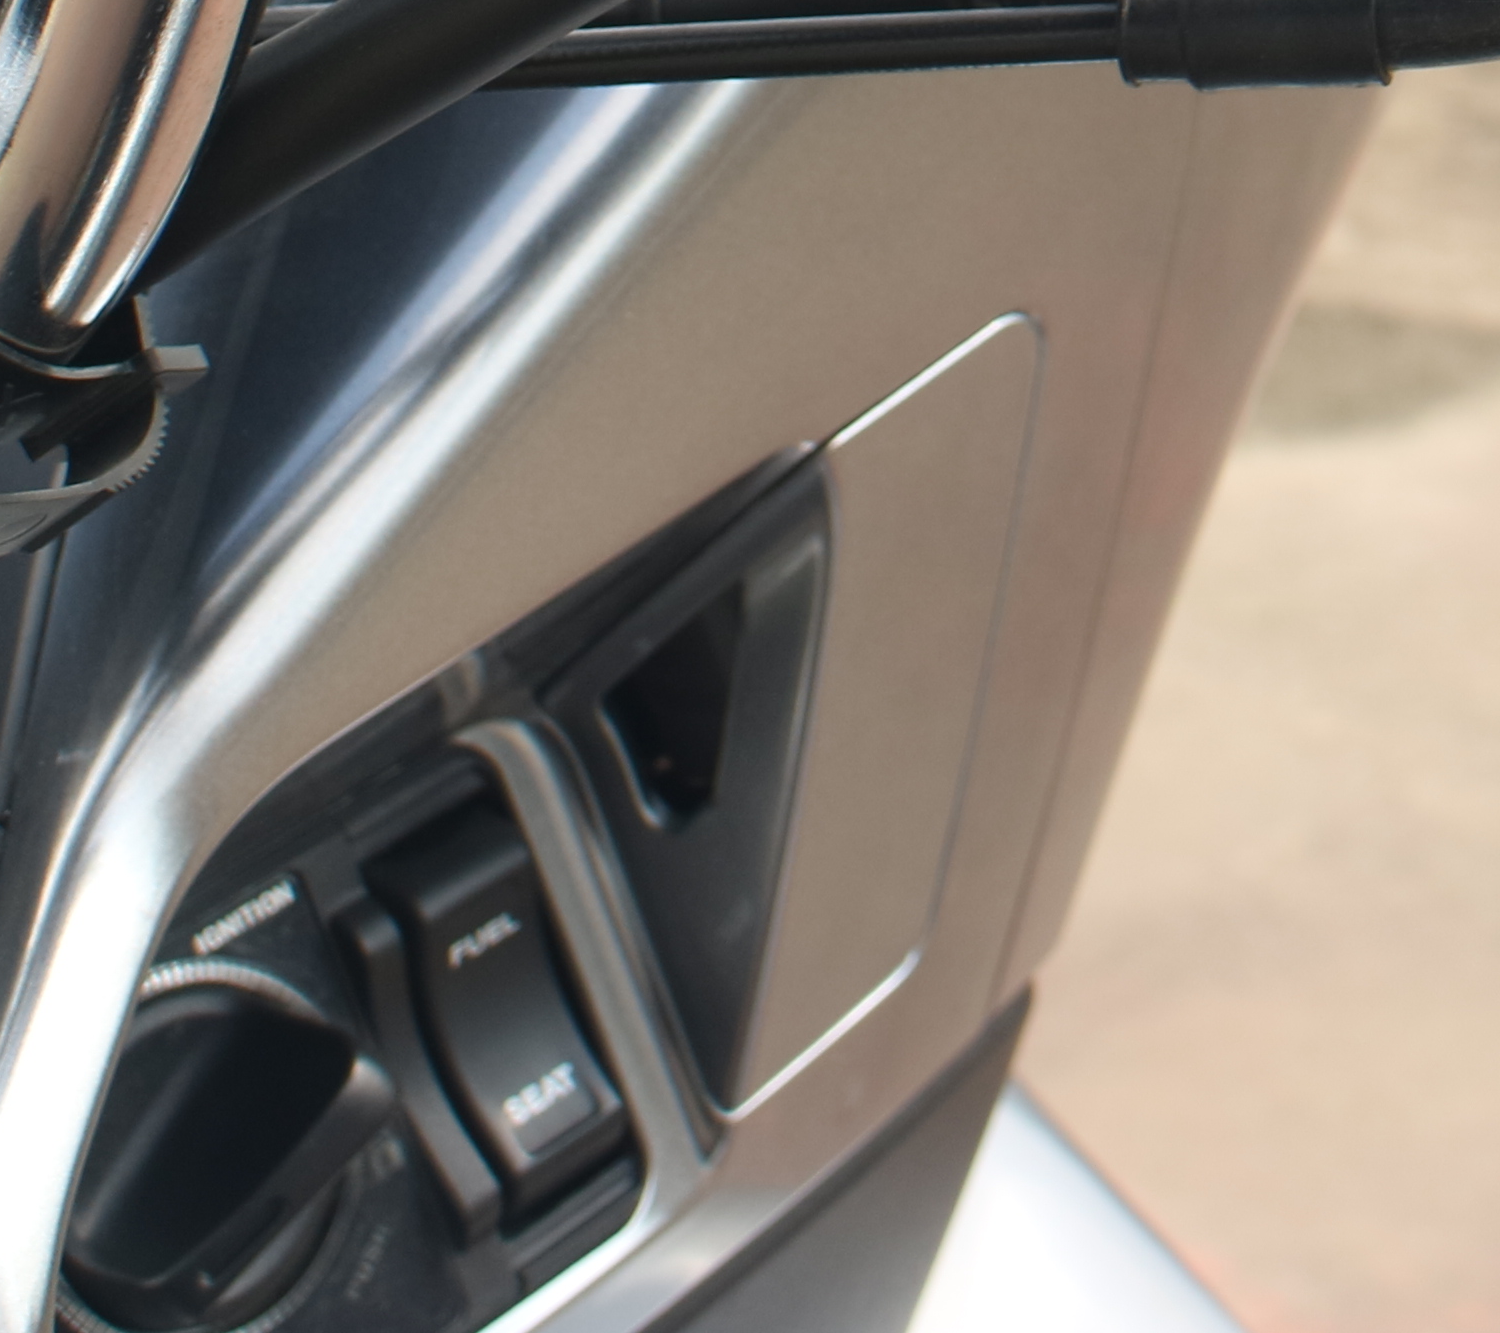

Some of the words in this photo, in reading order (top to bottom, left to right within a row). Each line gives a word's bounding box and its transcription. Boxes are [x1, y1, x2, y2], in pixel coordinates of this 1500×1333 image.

[191, 880, 296, 955] IGNITION
[447, 910, 522, 970] FUEL
[502, 1060, 577, 1126] SEAT
